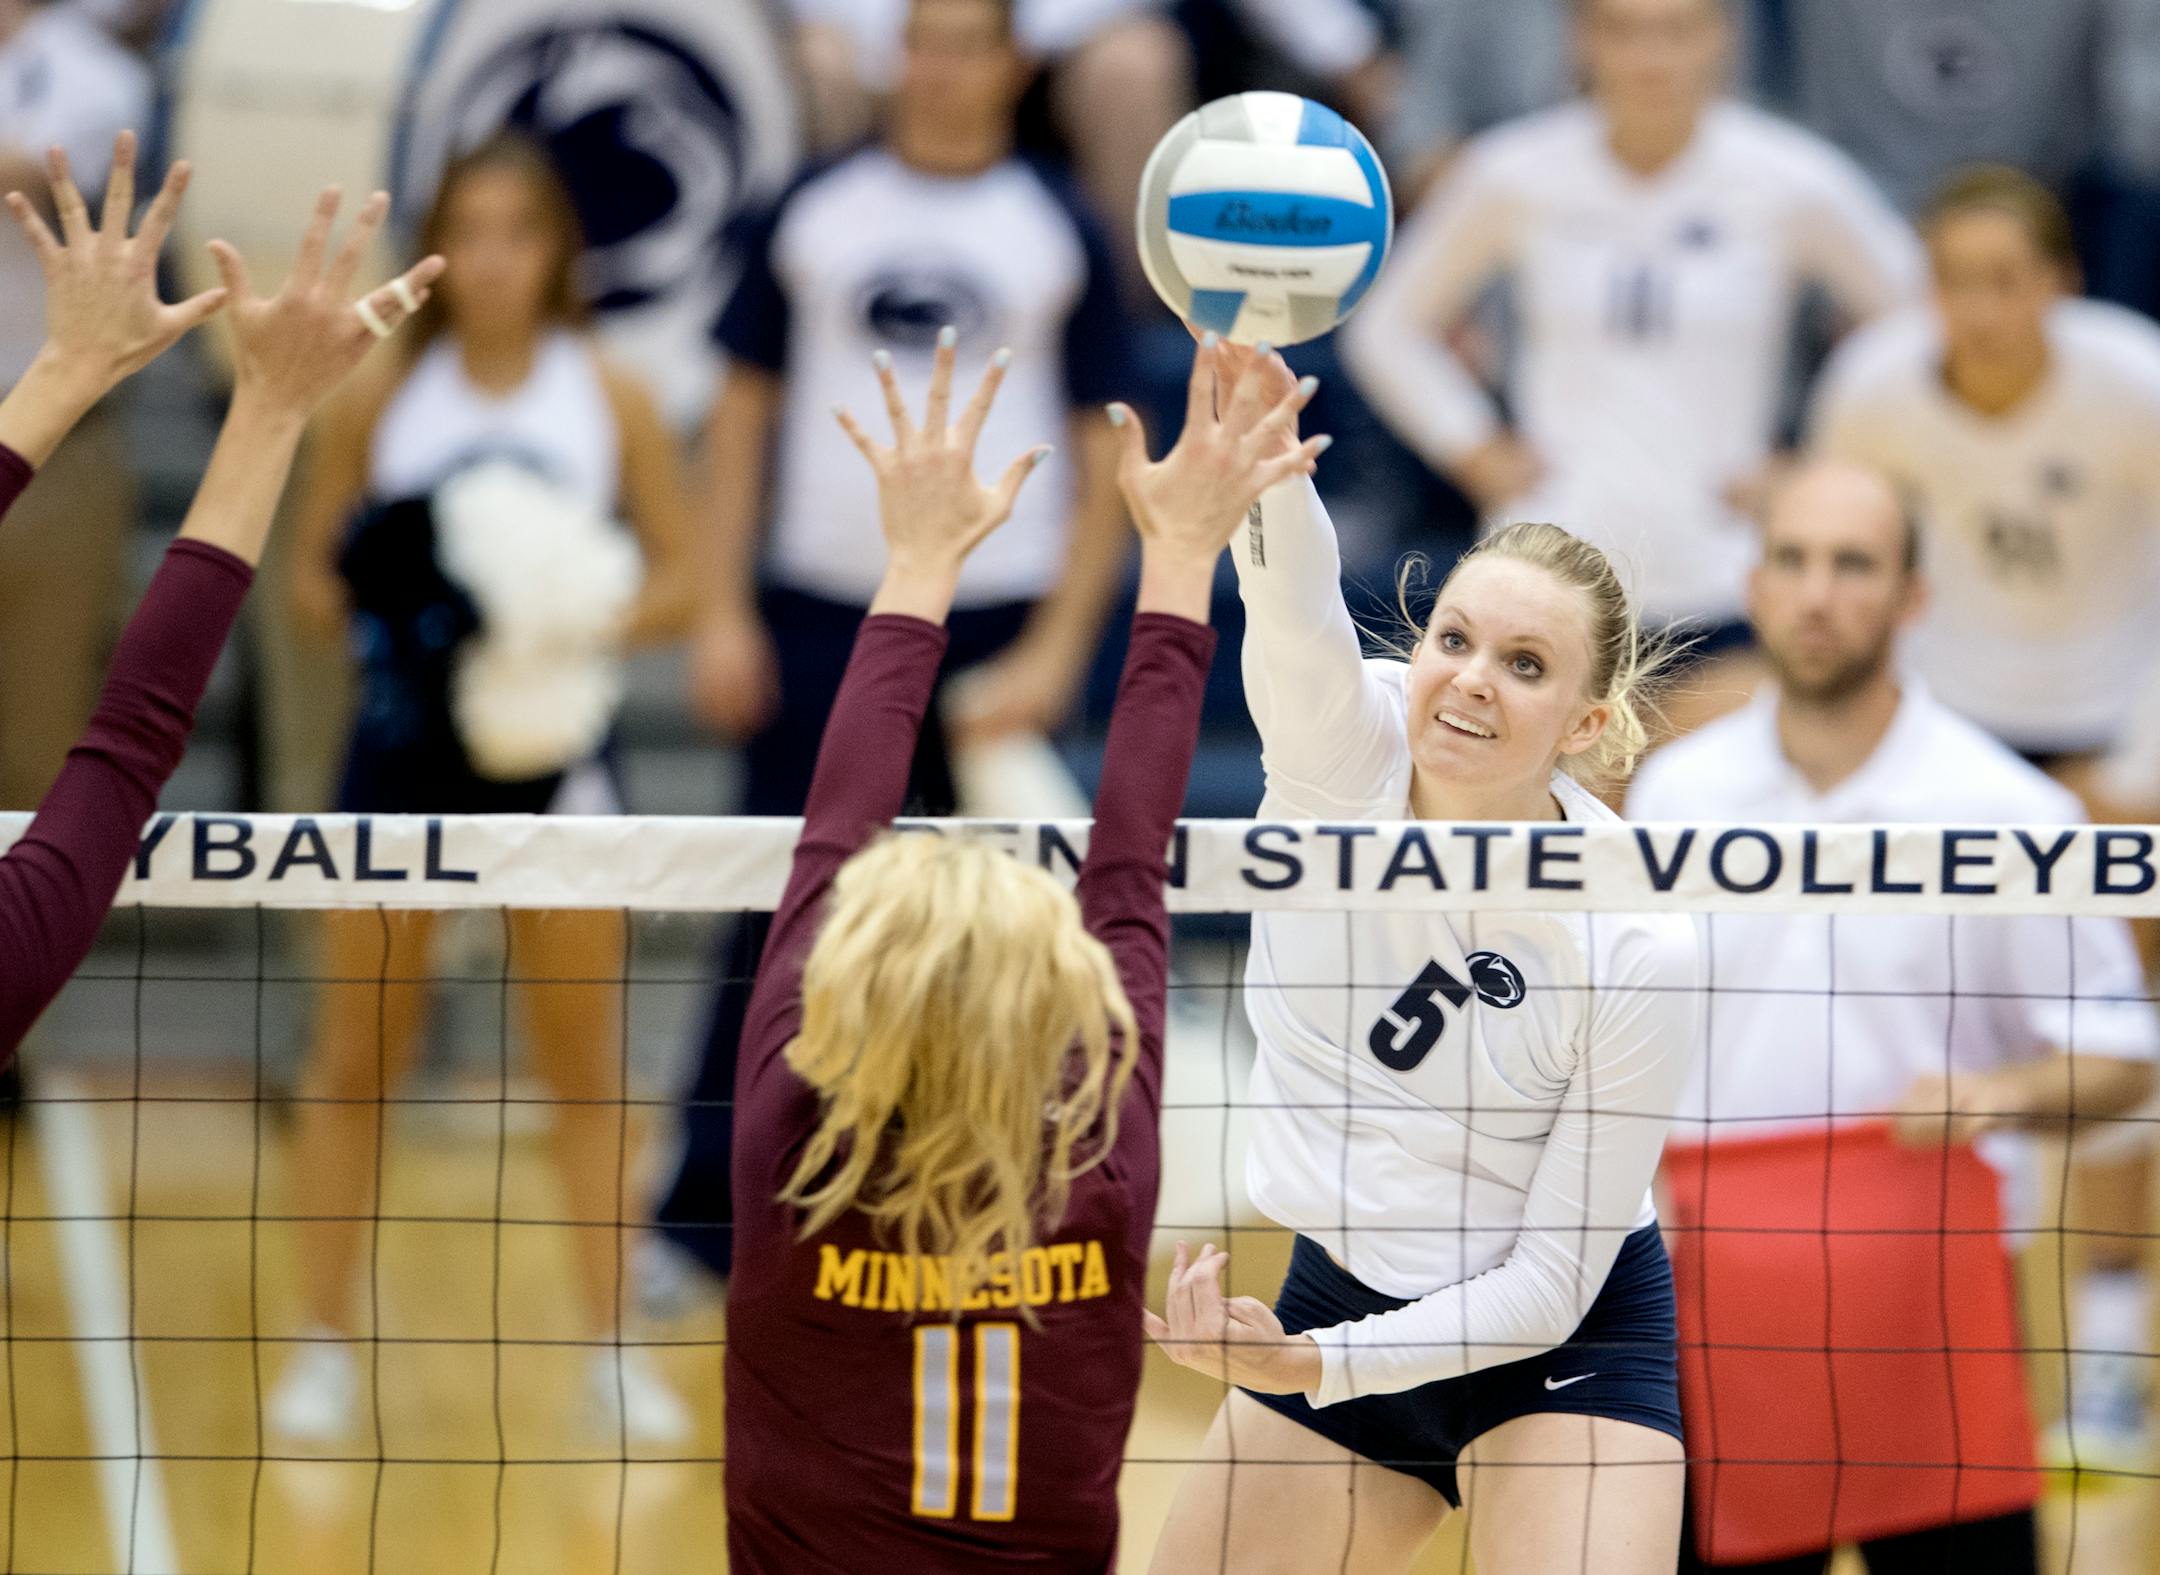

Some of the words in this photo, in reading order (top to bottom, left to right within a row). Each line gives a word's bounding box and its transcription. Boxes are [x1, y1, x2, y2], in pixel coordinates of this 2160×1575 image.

[1240, 825, 1585, 892] STATE
[1634, 828, 2157, 895] VOLLEYB
[1369, 959, 1474, 1072] 5
[911, 1322, 1020, 1522] 11
